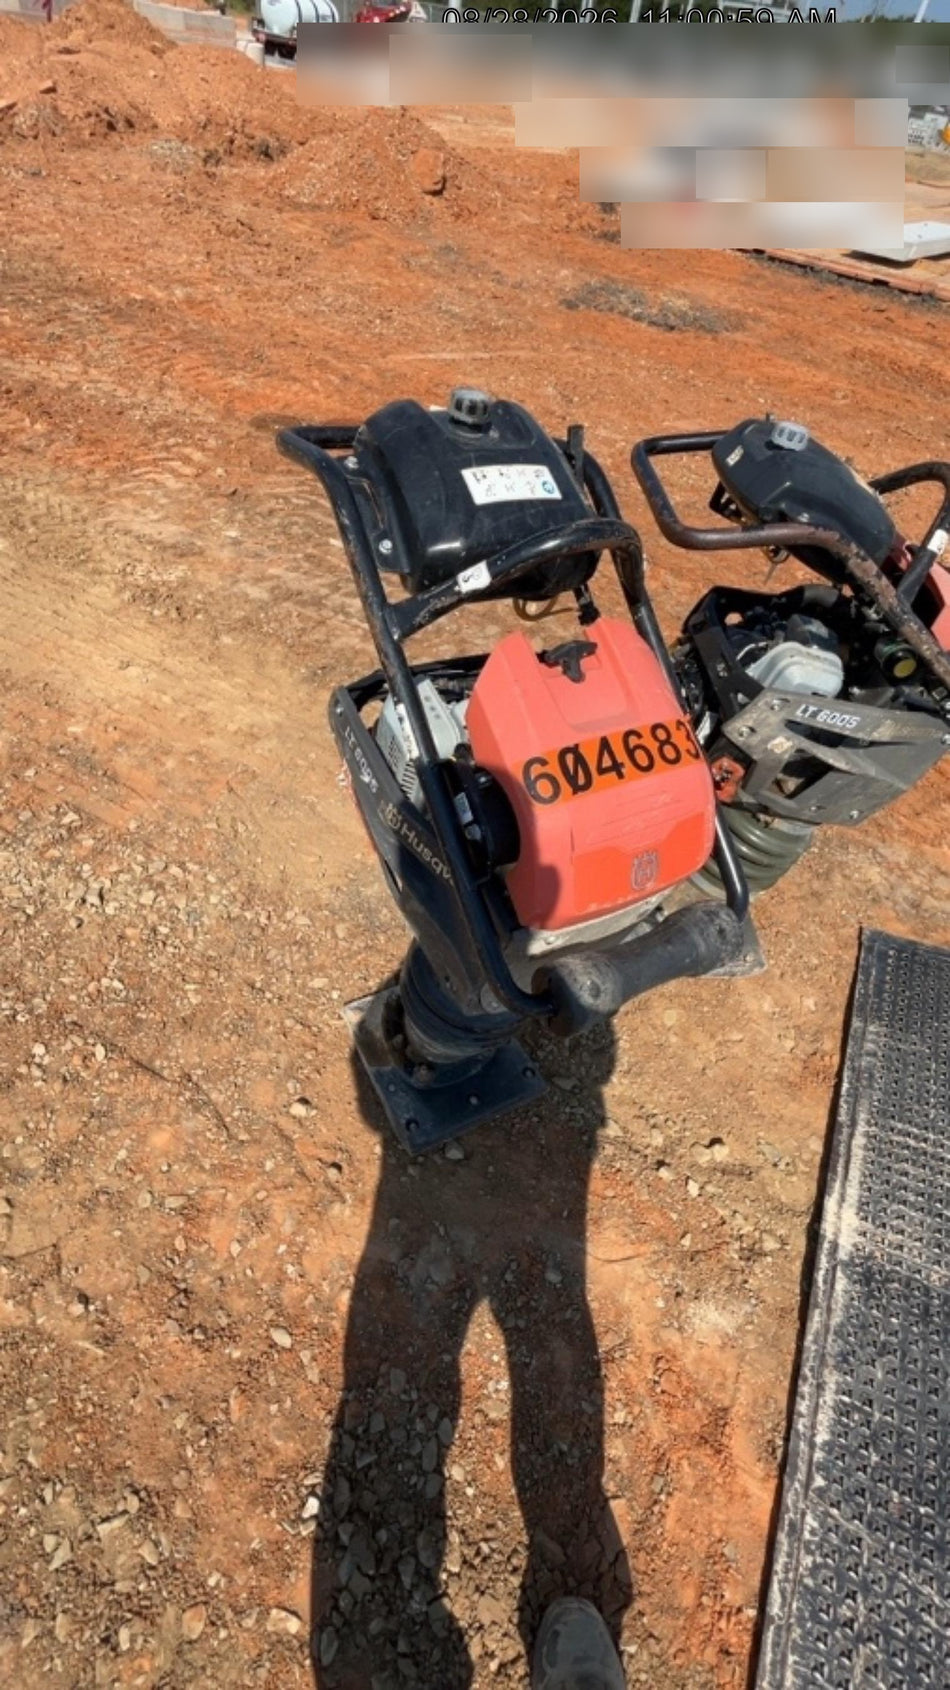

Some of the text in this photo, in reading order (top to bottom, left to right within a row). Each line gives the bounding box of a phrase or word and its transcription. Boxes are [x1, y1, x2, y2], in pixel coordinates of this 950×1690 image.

[796, 703, 862, 729] LT 6005
[400, 823, 455, 885] Husqv
